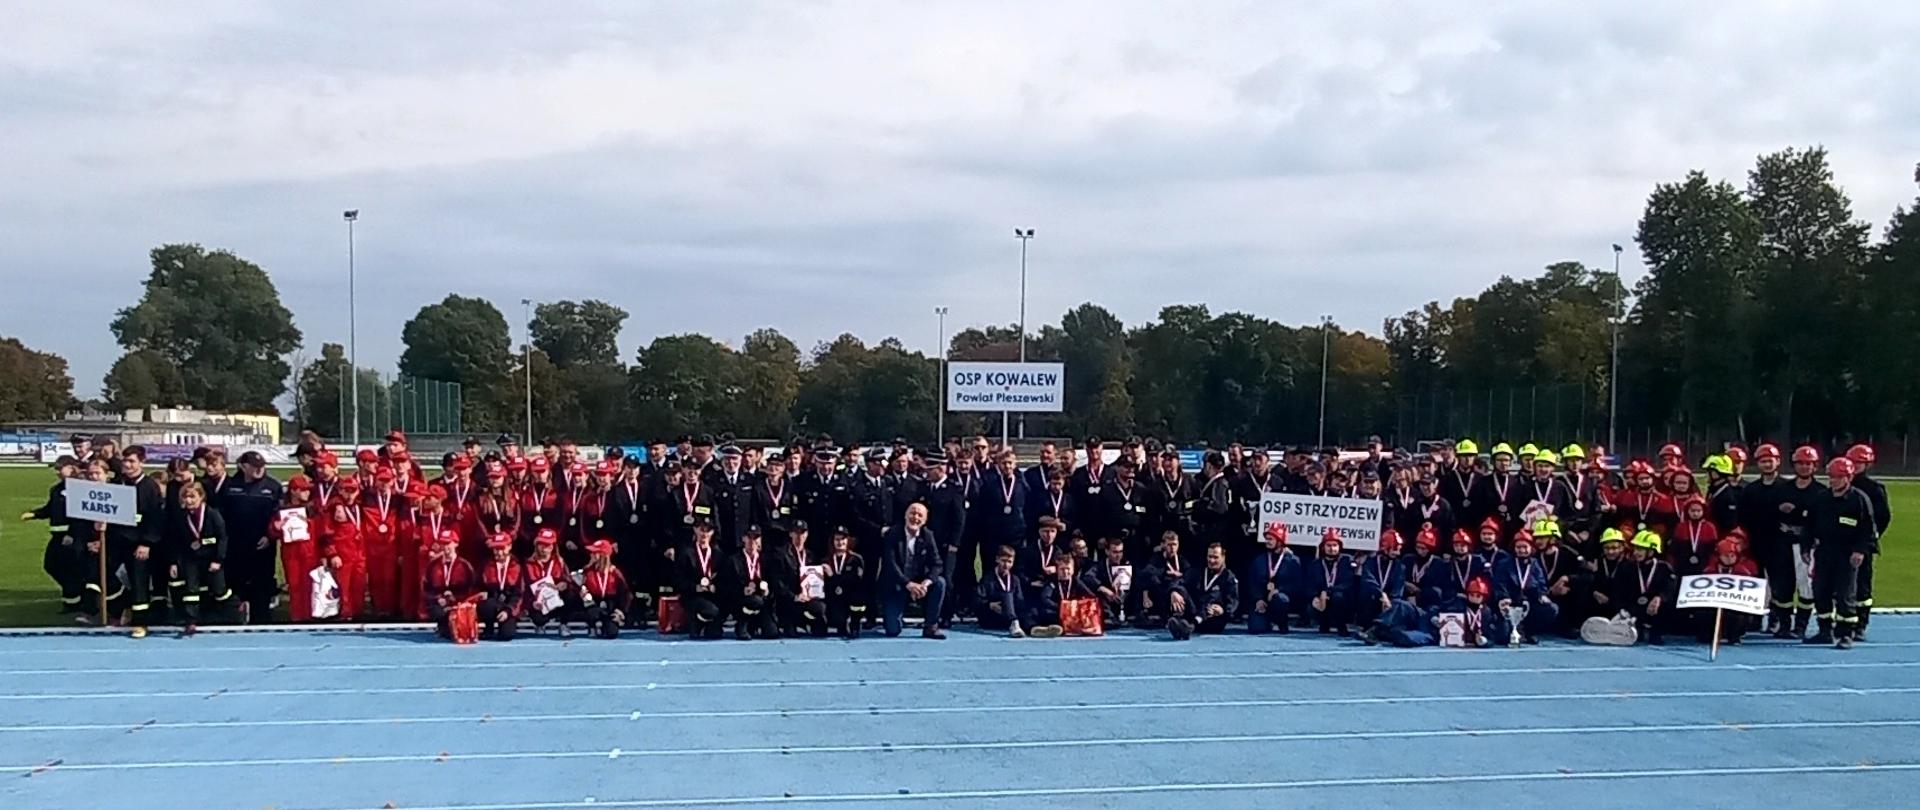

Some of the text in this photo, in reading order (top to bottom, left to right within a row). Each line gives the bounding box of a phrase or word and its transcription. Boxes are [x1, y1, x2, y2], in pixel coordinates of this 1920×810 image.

[954, 372, 1057, 387] OSP KOWALEW
[956, 392, 1054, 403] Powiat Pleszewski
[89, 490, 112, 502] OSP
[81, 501, 119, 515] KARSY
[1263, 500, 1379, 521] OSP STRZYDZEW
[1689, 577, 1759, 592] OSP
[1685, 590, 1759, 603] CZERMIN
